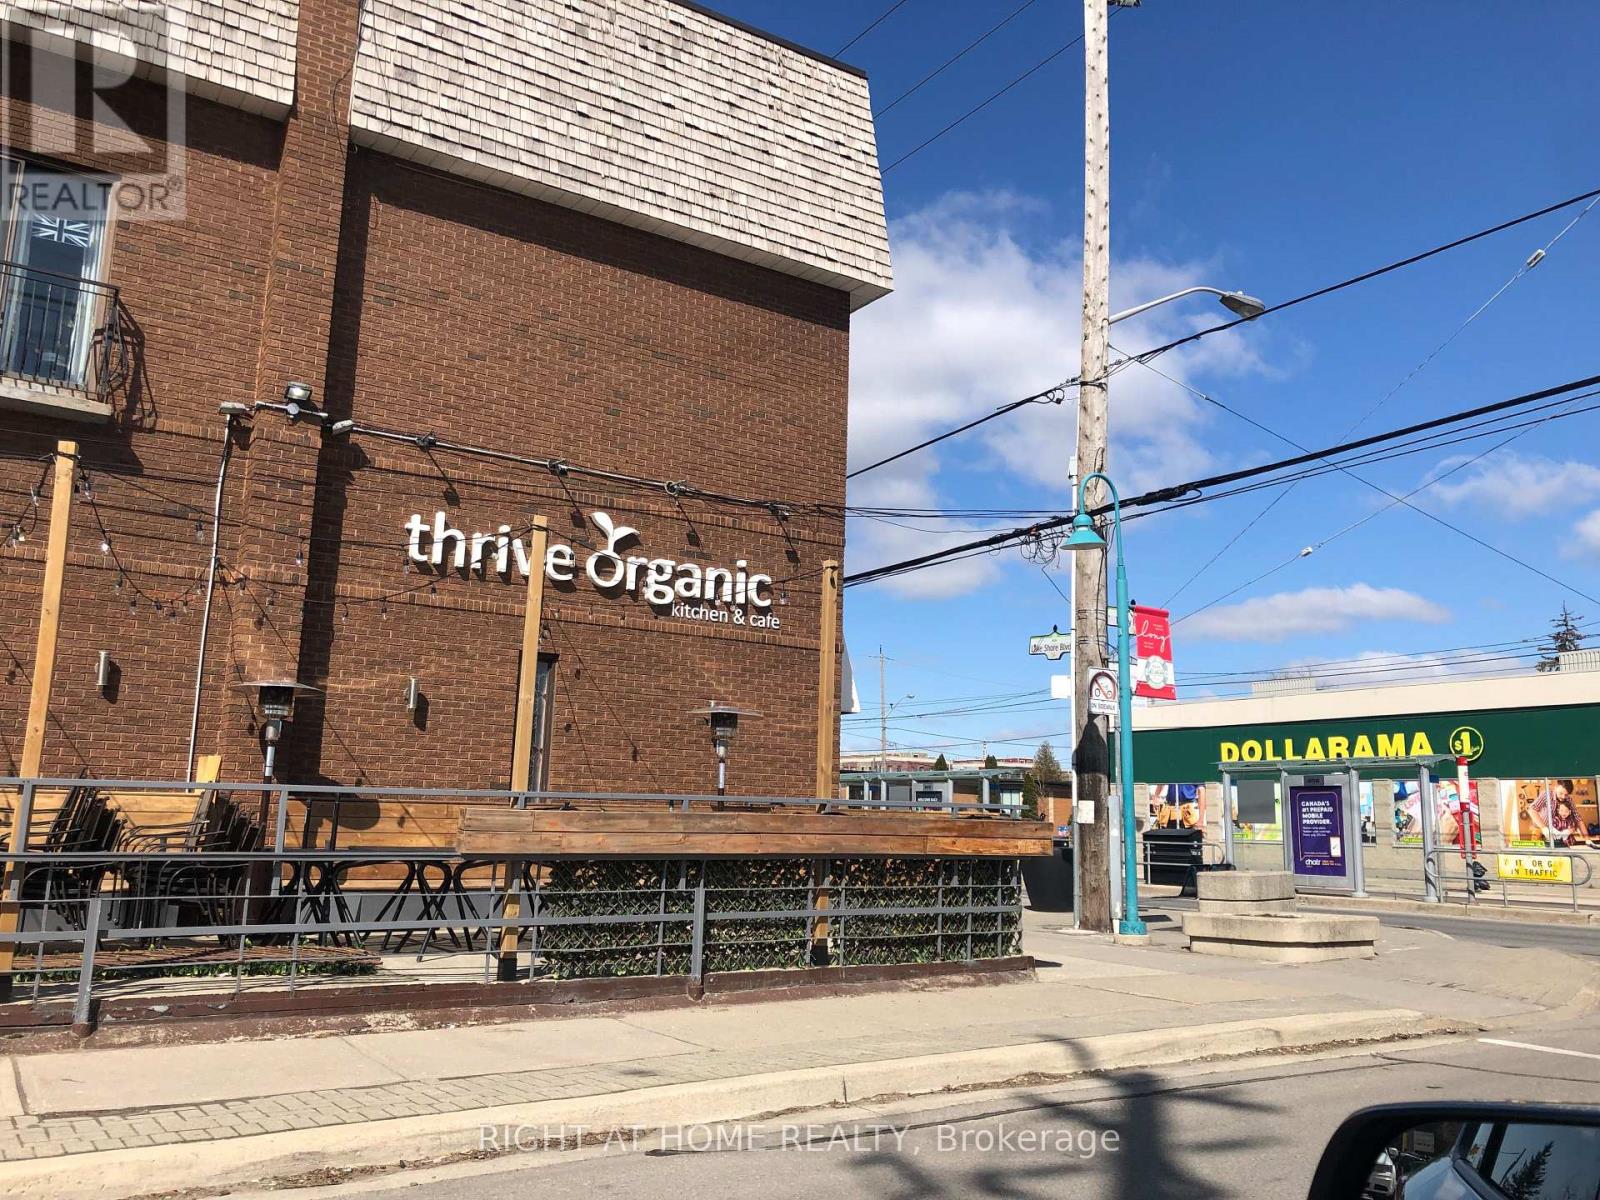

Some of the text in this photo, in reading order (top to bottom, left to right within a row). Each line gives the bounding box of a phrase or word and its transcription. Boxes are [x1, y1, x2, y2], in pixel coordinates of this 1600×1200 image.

[404, 511, 574, 582] thrive
[671, 601, 780, 629] kitchen & cafe
[1044, 644, 1059, 652] Shore
[1220, 731, 1434, 762] DOLLARAMA
[1525, 868, 1558, 878] TRAFFIC
